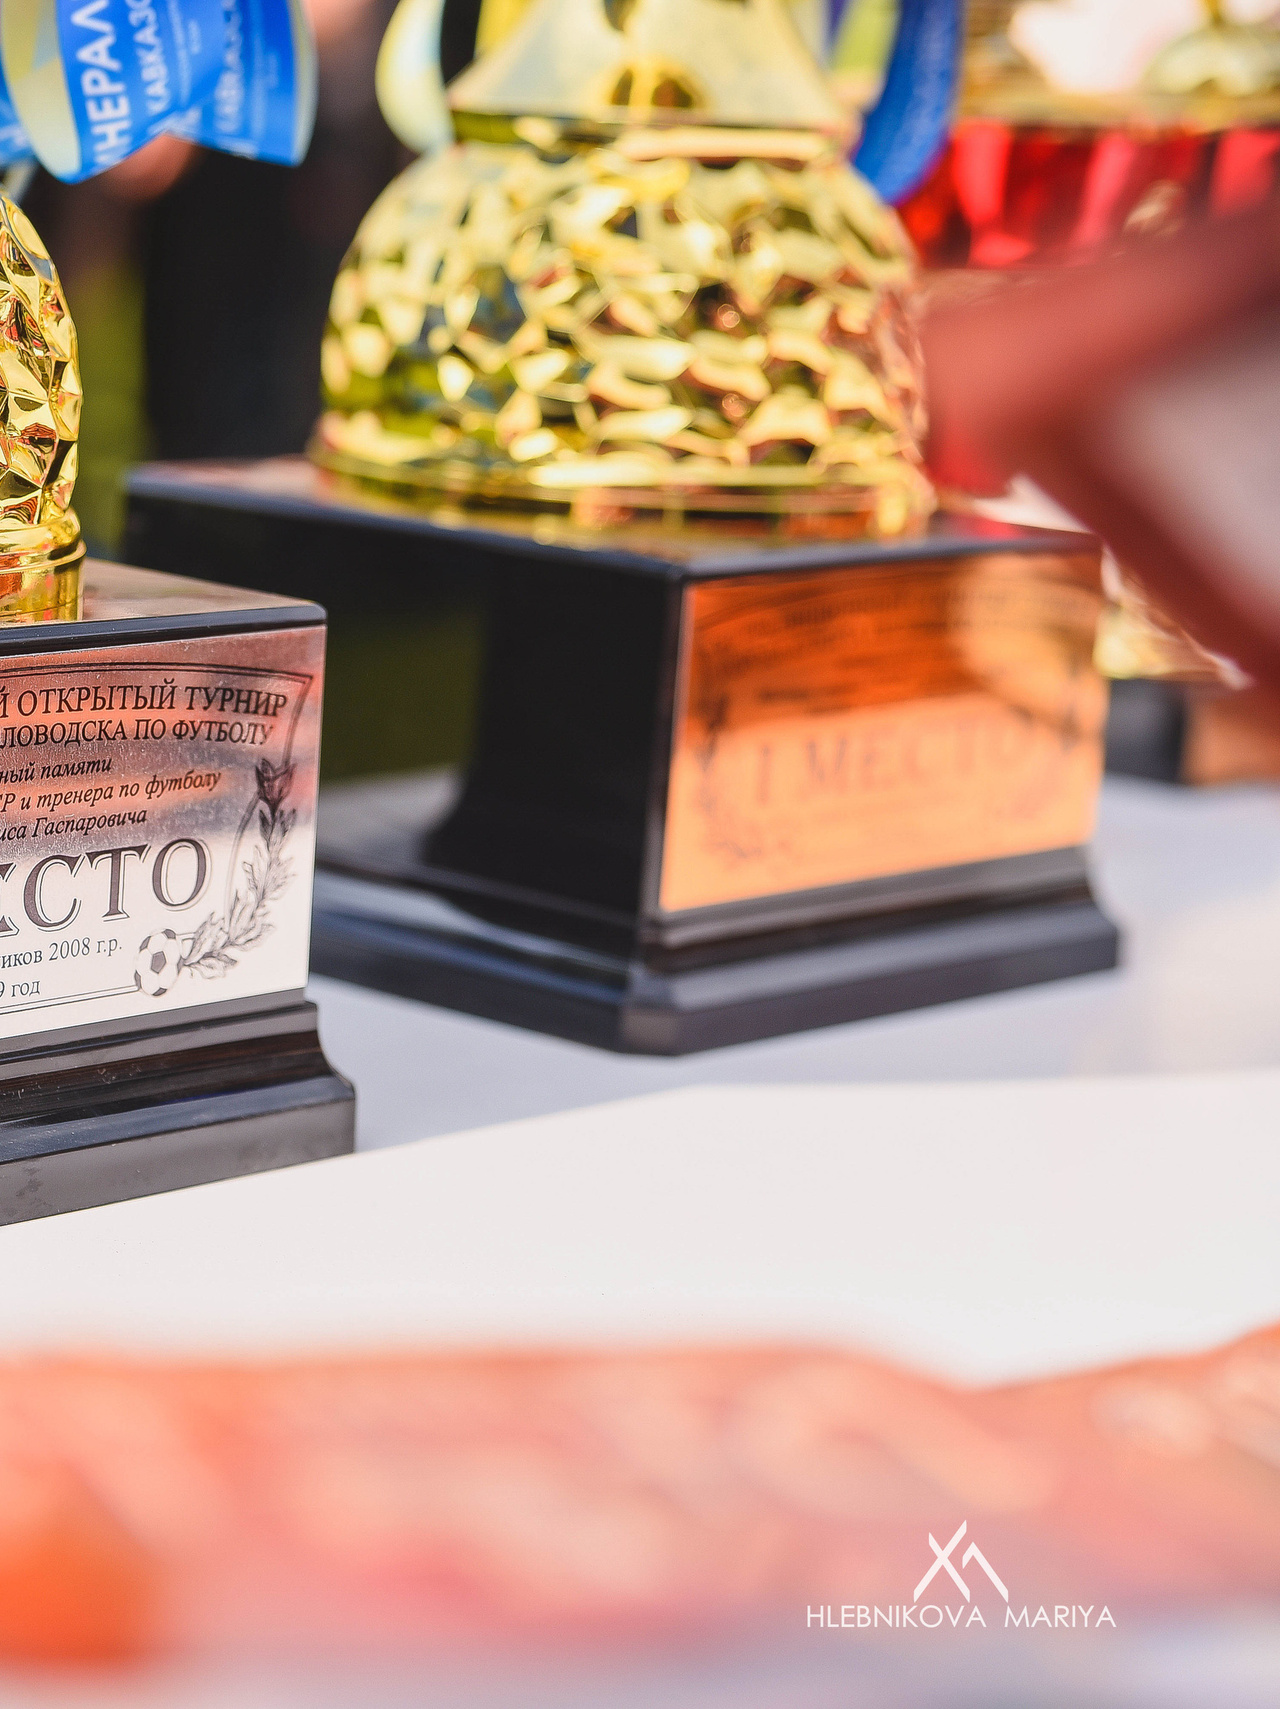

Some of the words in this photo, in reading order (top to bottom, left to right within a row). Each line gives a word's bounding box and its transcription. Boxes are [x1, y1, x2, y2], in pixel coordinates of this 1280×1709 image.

[16, 678, 178, 716] ОТКРЫТЫЙ
[184, 685, 289, 718] ТУРНИР
[133, 718, 167, 740] ПО
[172, 719, 274, 746] ФУТБОЛУ
[40, 757, 113, 779] памяти
[20, 797, 31, 811] и
[37, 787, 113, 811] тренера
[119, 783, 140, 798] по
[145, 769, 222, 799] футболу
[32, 809, 148, 839] Гаспаровича
[48, 936, 91, 962] 2008
[95, 939, 123, 958] г.р.
[10, 978, 41, 998] год
